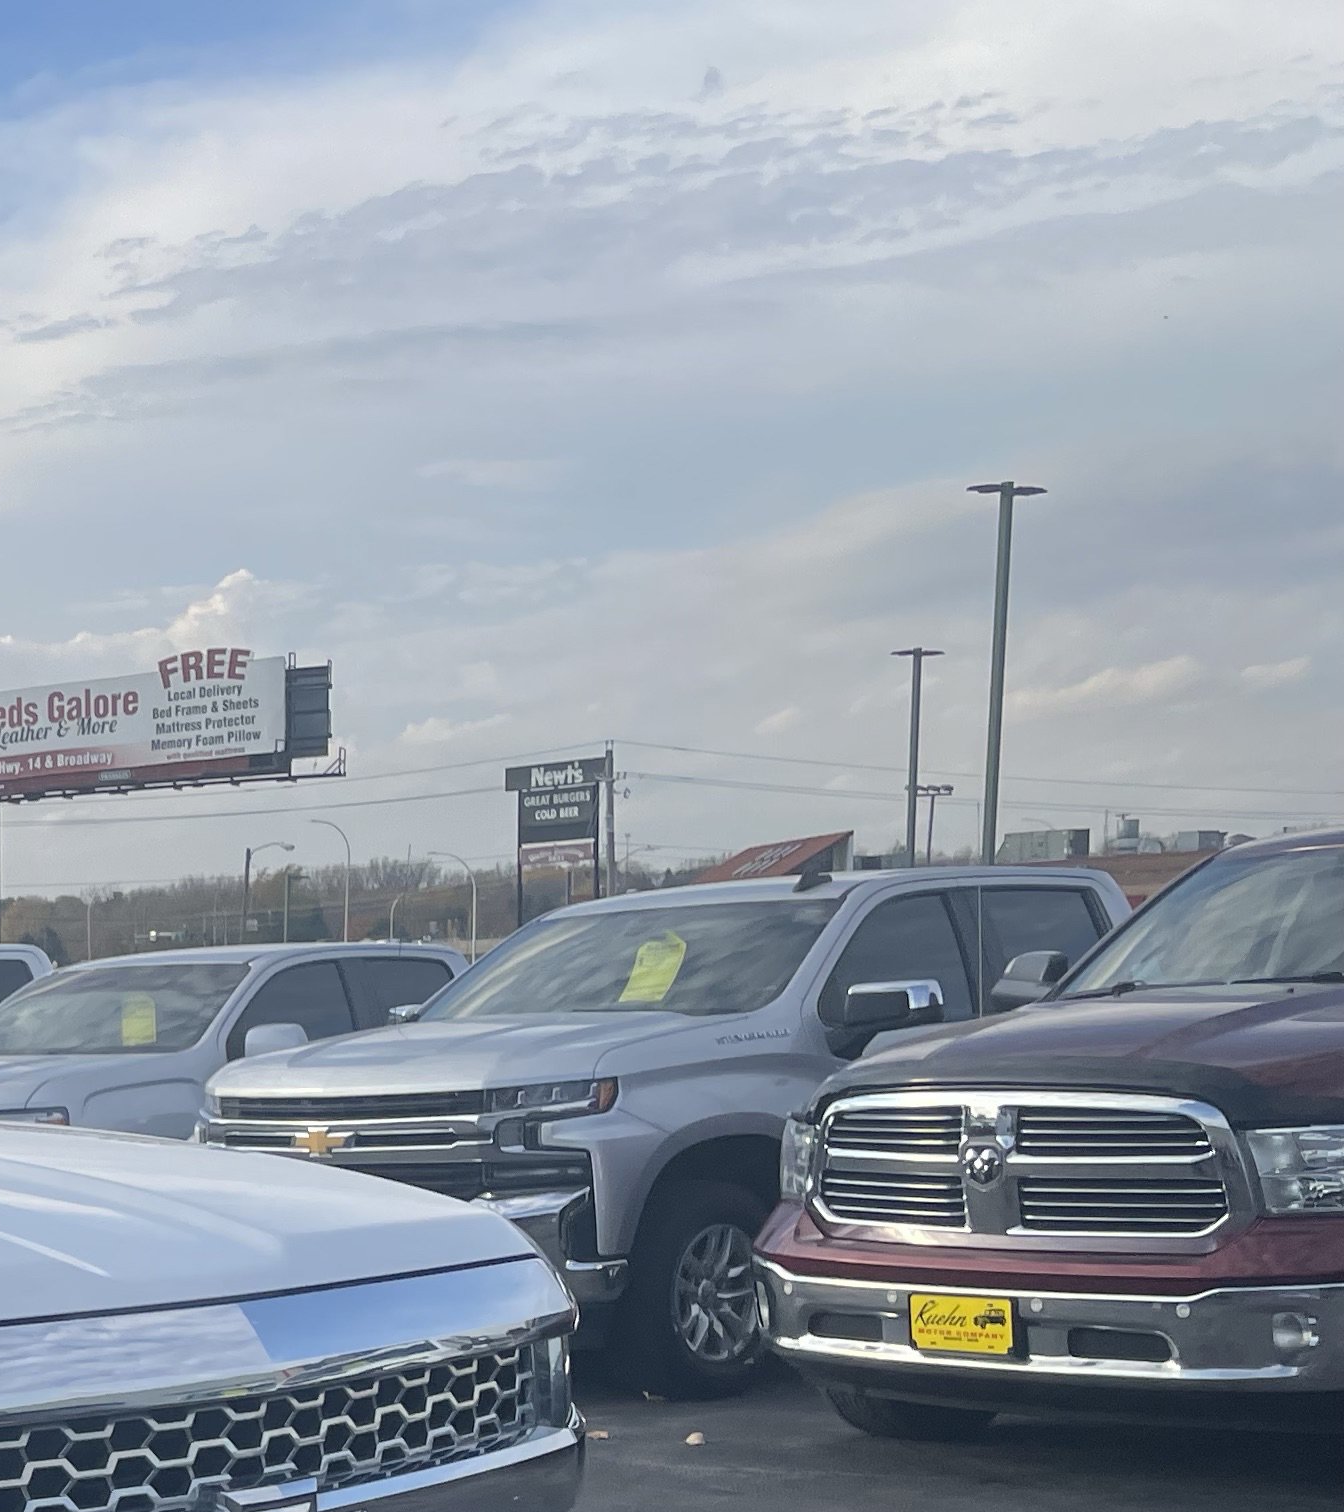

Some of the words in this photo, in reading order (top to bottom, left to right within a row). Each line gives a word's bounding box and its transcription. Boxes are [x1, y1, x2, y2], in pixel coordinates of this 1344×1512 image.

[158, 648, 251, 689] FREE
[167, 687, 196, 702] Local
[199, 684, 243, 698] Delivery
[47, 688, 139, 723] Galore
[152, 706, 172, 719] Bed
[175, 704, 208, 717] Frame
[211, 701, 219, 713] &
[222, 697, 259, 712] Sheets
[56, 719, 70, 738] &
[77, 716, 118, 737] More
[156, 721, 202, 735] Mattress
[205, 714, 256, 730] Protector
[150, 738, 192, 751] Memory
[196, 734, 224, 747] Foam
[227, 730, 262, 743] Pillow
[28, 756, 41, 770] 14
[44, 755, 53, 768] &
[57, 751, 113, 768] Broadway
[531, 761, 584, 787] Newt's
[524, 794, 550, 807] GREAT
[553, 790, 591, 805] BURGERS
[534, 809, 557, 820] COLD
[559, 806, 579, 818] BEER
[915, 1300, 968, 1327] Kuehn
[918, 1328, 952, 1336] MOTOR
[956, 1331, 1004, 1340] COMPANY
